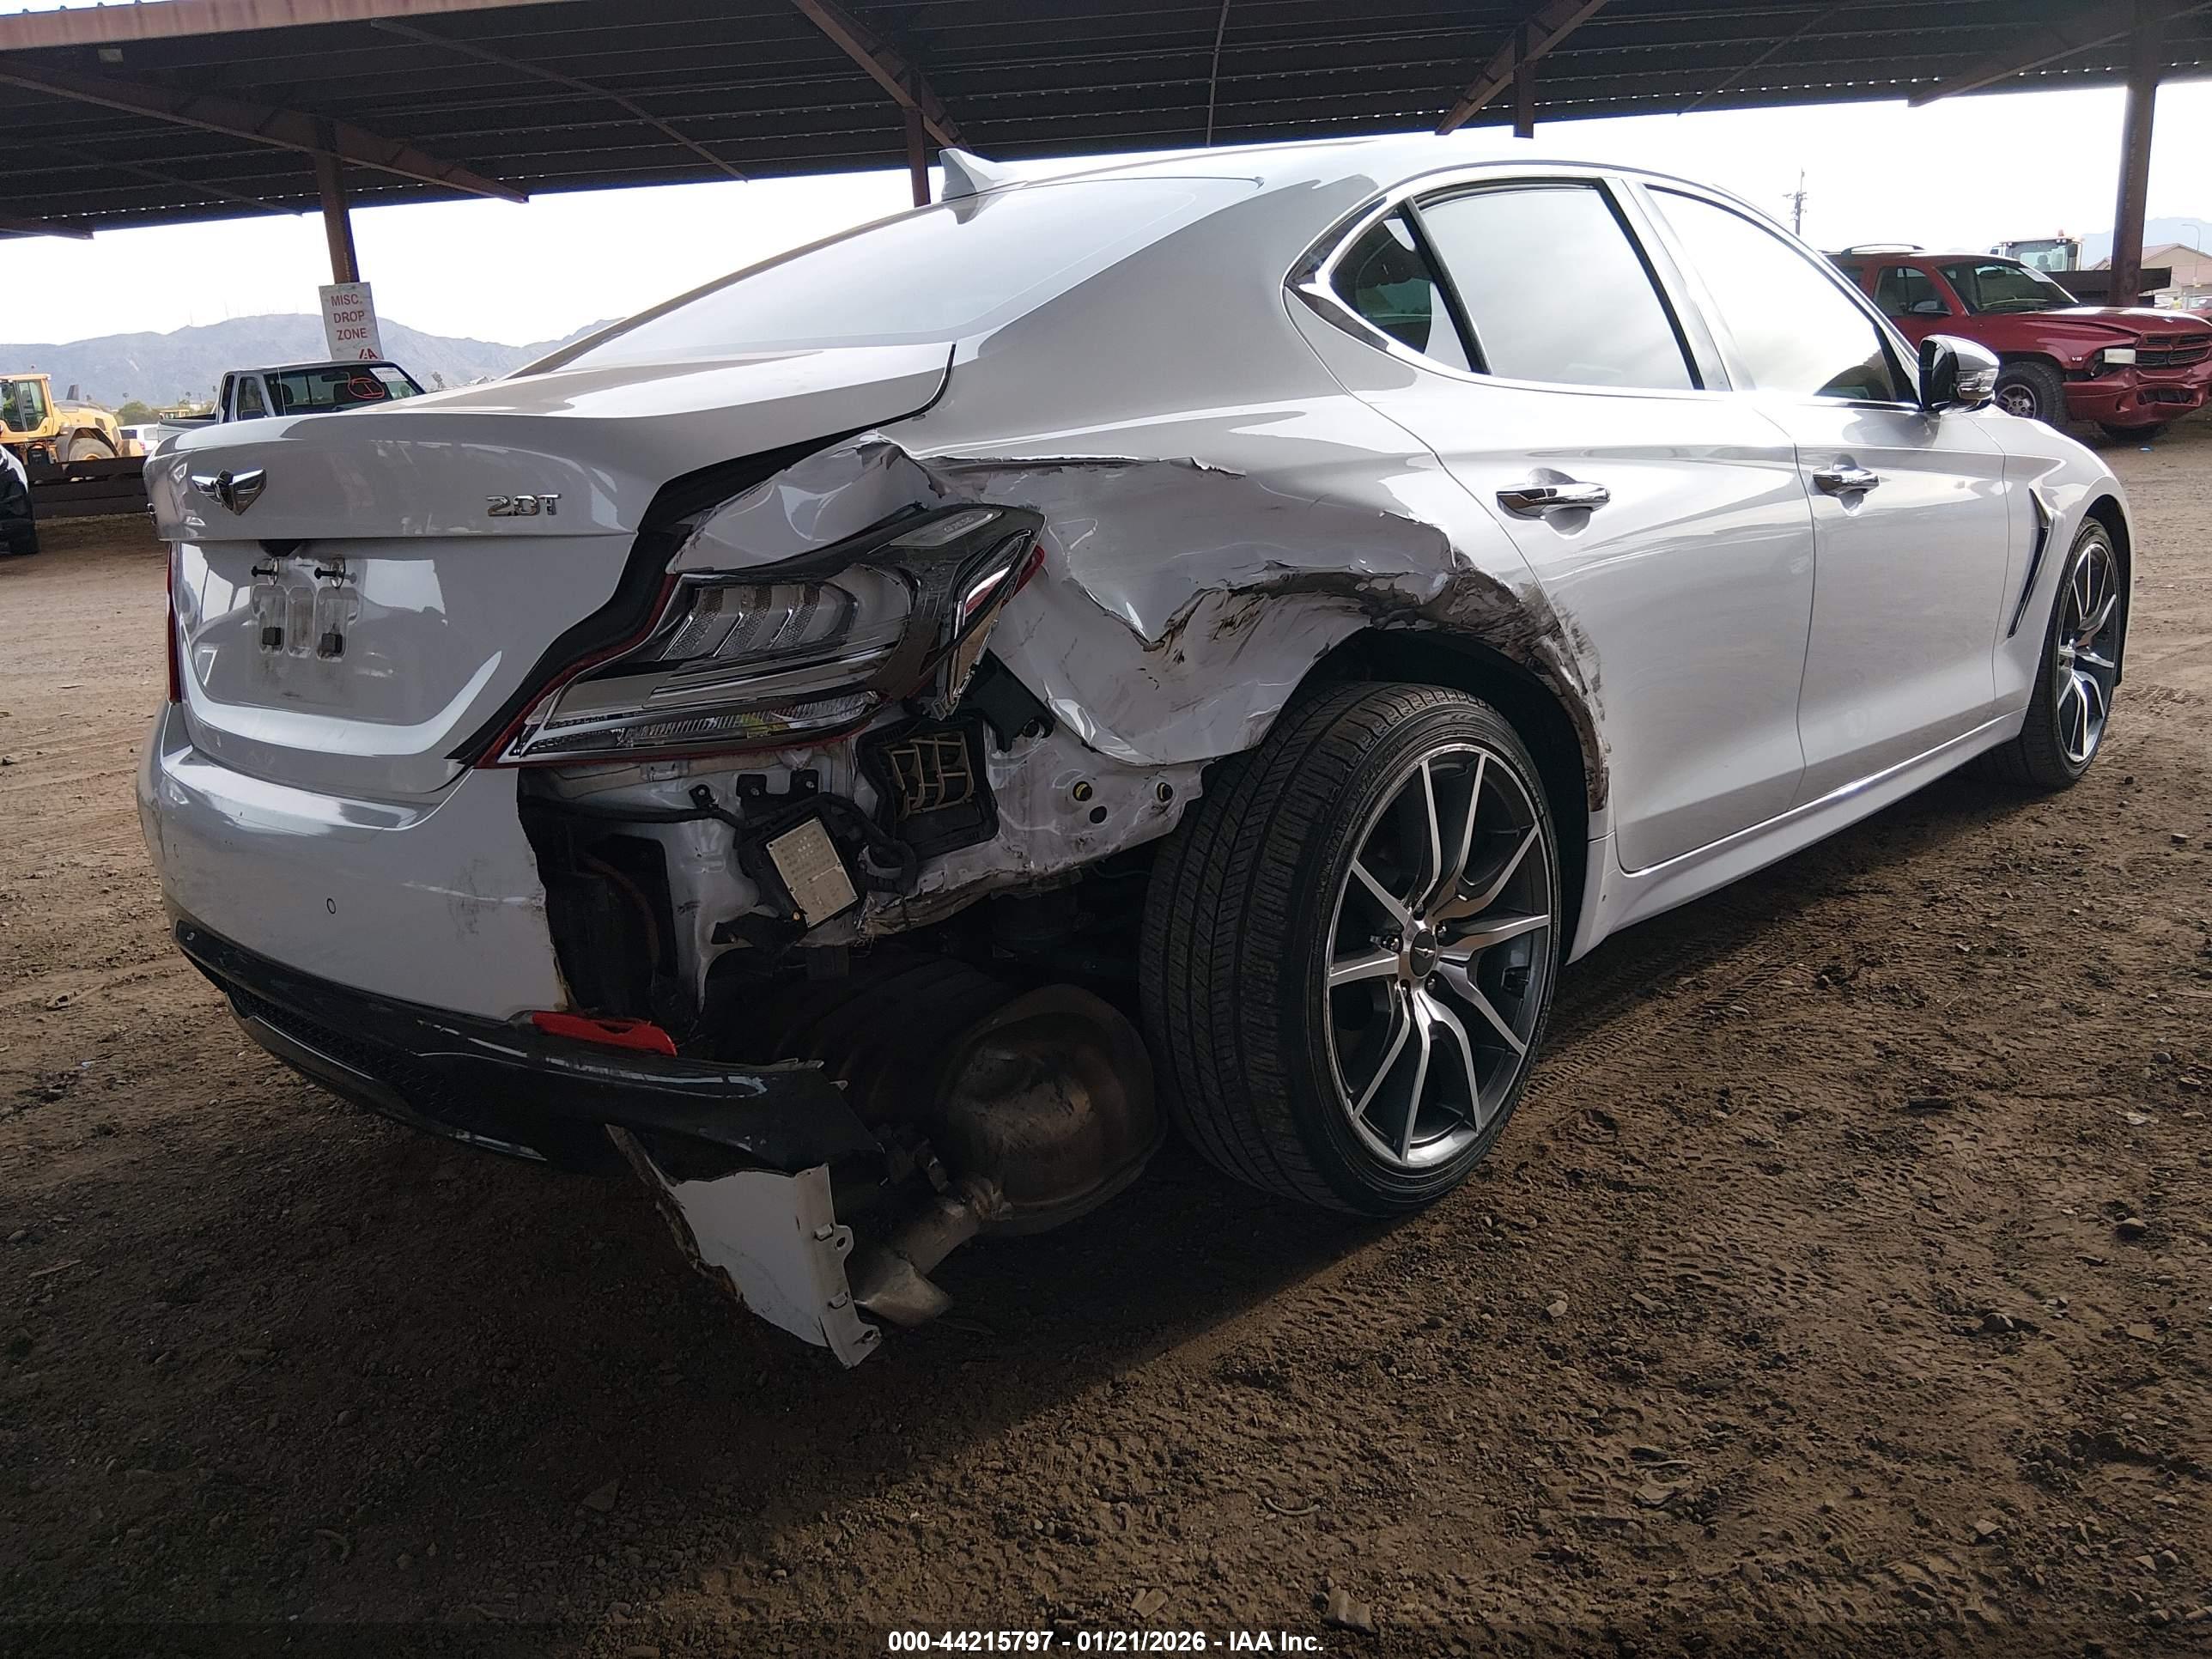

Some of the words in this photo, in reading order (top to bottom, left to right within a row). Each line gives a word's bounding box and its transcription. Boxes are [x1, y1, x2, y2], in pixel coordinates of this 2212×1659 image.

[331, 294, 362, 307] MISC.
[333, 310, 364, 324] DROP
[337, 327, 368, 341] ZONE
[487, 494, 562, 516] 2.0T
